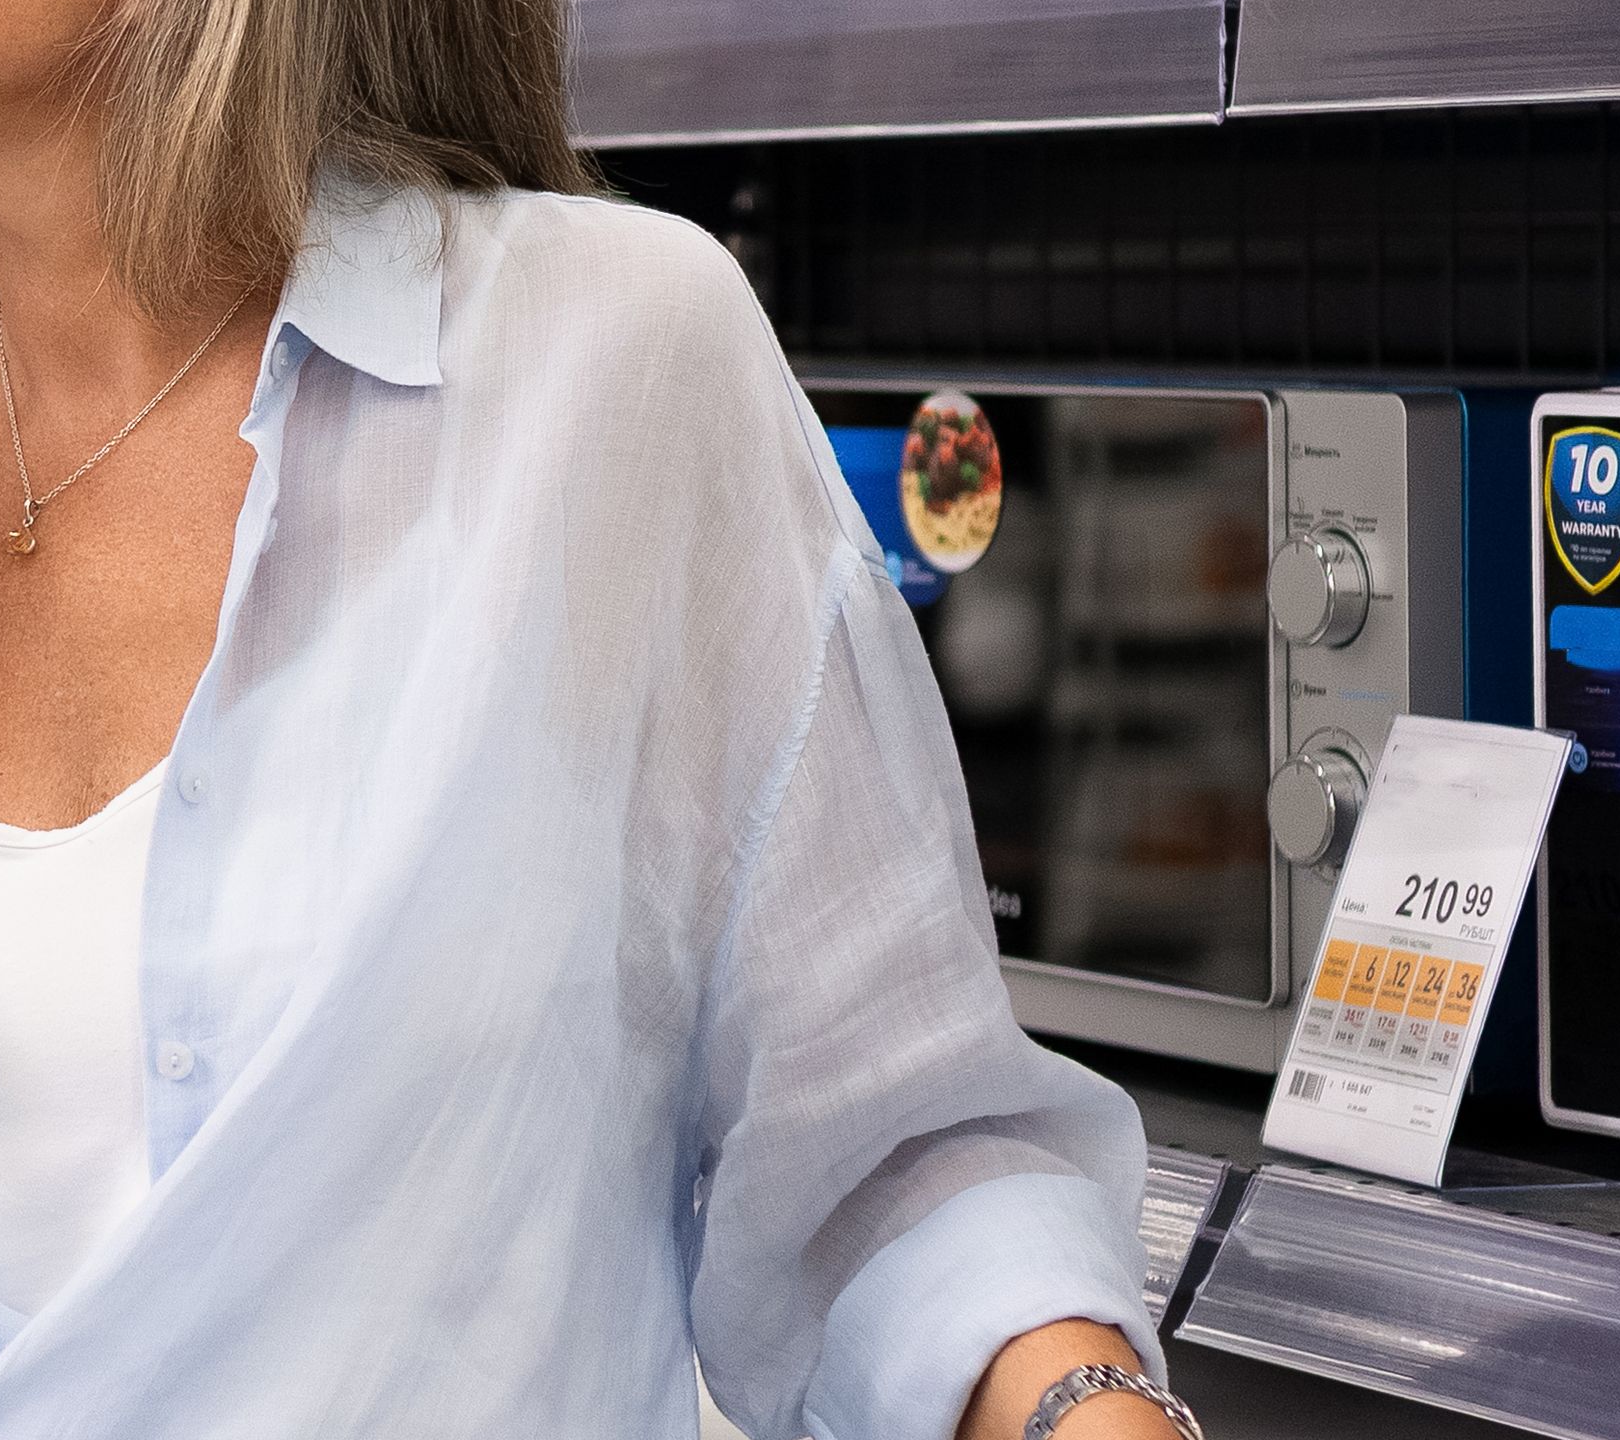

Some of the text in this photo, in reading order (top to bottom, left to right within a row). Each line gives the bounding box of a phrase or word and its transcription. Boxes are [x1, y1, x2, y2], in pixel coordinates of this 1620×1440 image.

[1571, 444, 1619, 496] 10
[1576, 499, 1607, 515] YEAR
[988, 885, 1022, 918] dea
[1394, 874, 1494, 925] 210 99
[1365, 956, 1378, 982] 6
[1392, 960, 1411, 988] 12
[1422, 967, 1446, 996] 24
[1456, 972, 1479, 1001] 36
